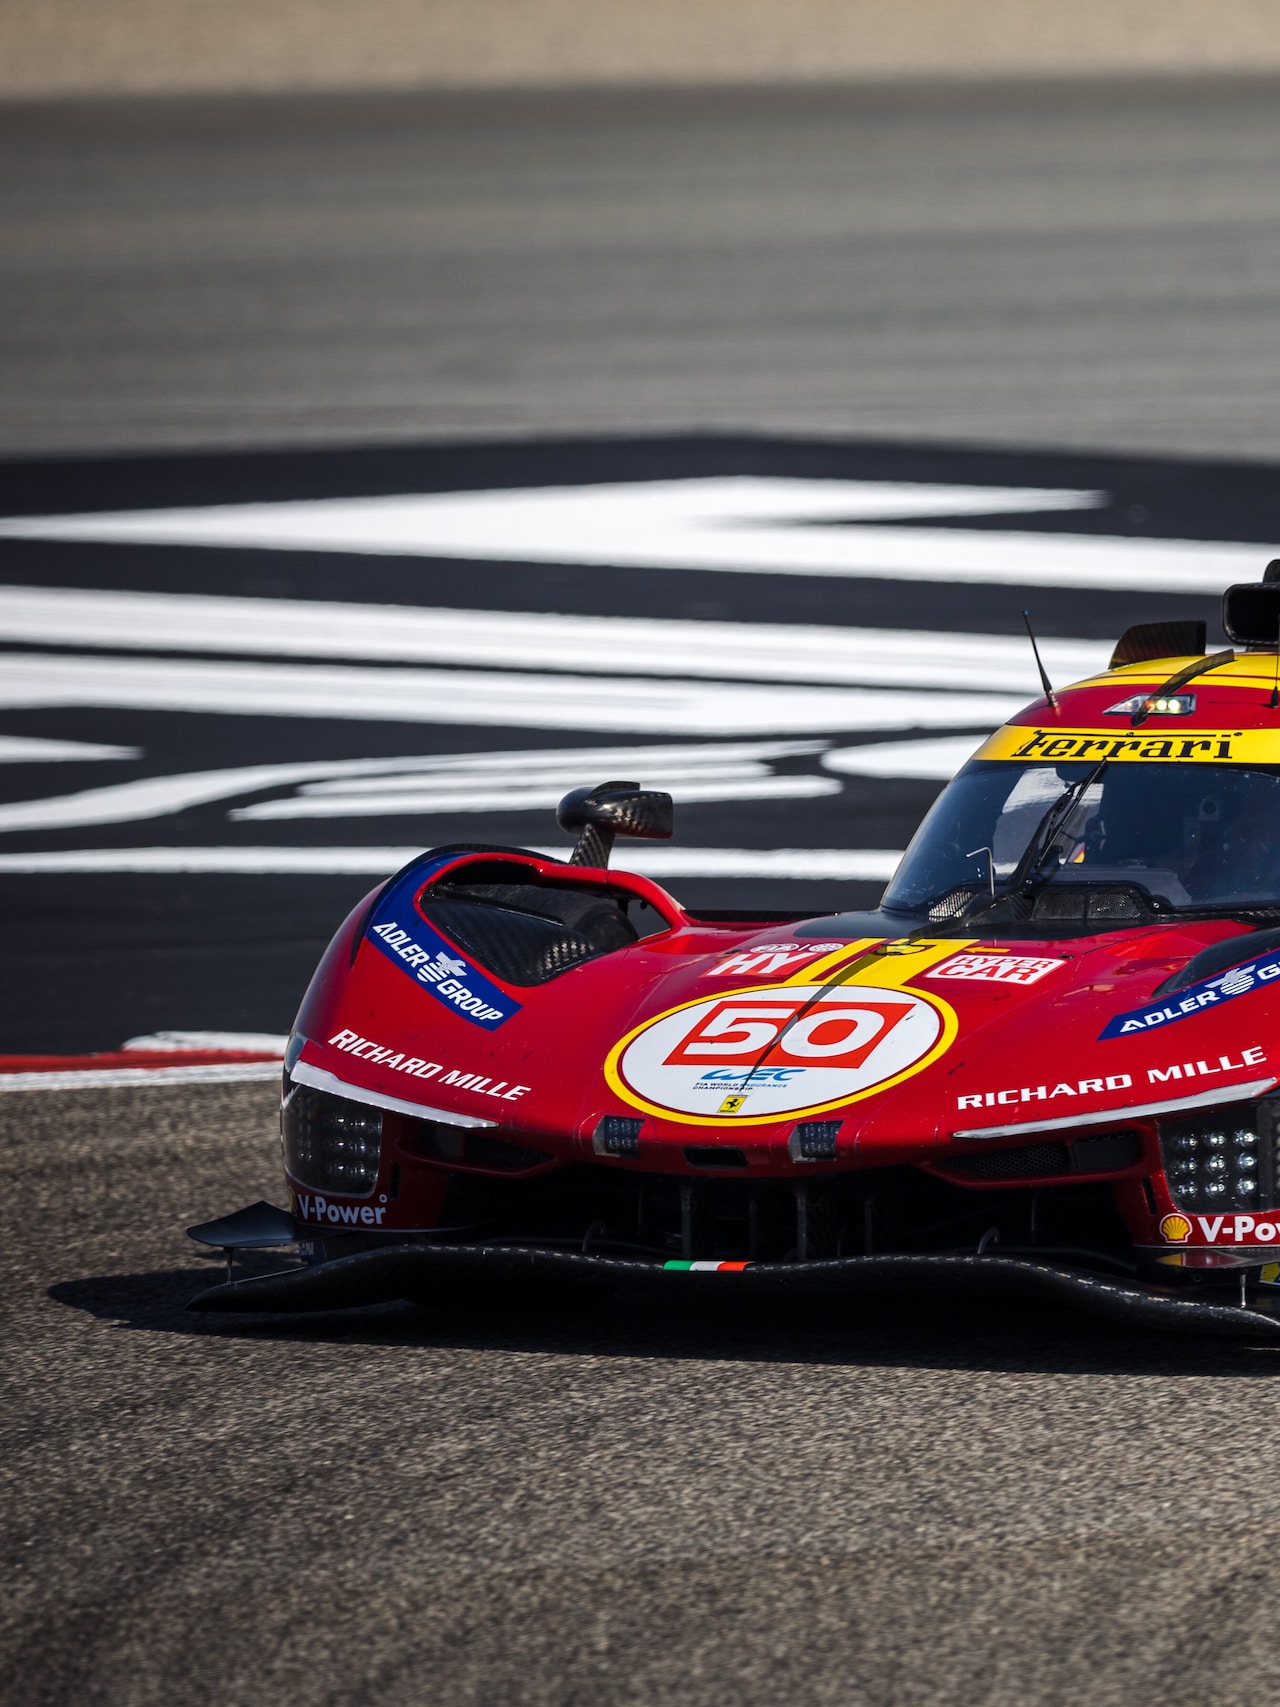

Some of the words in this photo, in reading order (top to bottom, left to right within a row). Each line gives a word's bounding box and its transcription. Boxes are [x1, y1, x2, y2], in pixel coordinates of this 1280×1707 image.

[1011, 729, 1243, 760] Ferrari
[372, 922, 430, 968] ADLER
[437, 979, 504, 1021] GROUP
[707, 952, 817, 976] HY
[939, 964, 1041, 981] CAR
[956, 956, 1050, 969] HYPER
[1120, 990, 1220, 1033] ADLER
[683, 1008, 885, 1057] 50
[328, 1029, 444, 1079] RICHARD
[438, 1069, 531, 1100] MILLE
[700, 1068, 806, 1081] WEC
[957, 1074, 1131, 1110] RICHARD
[1149, 1046, 1267, 1083] MILLE
[297, 1194, 387, 1225] V-Power
